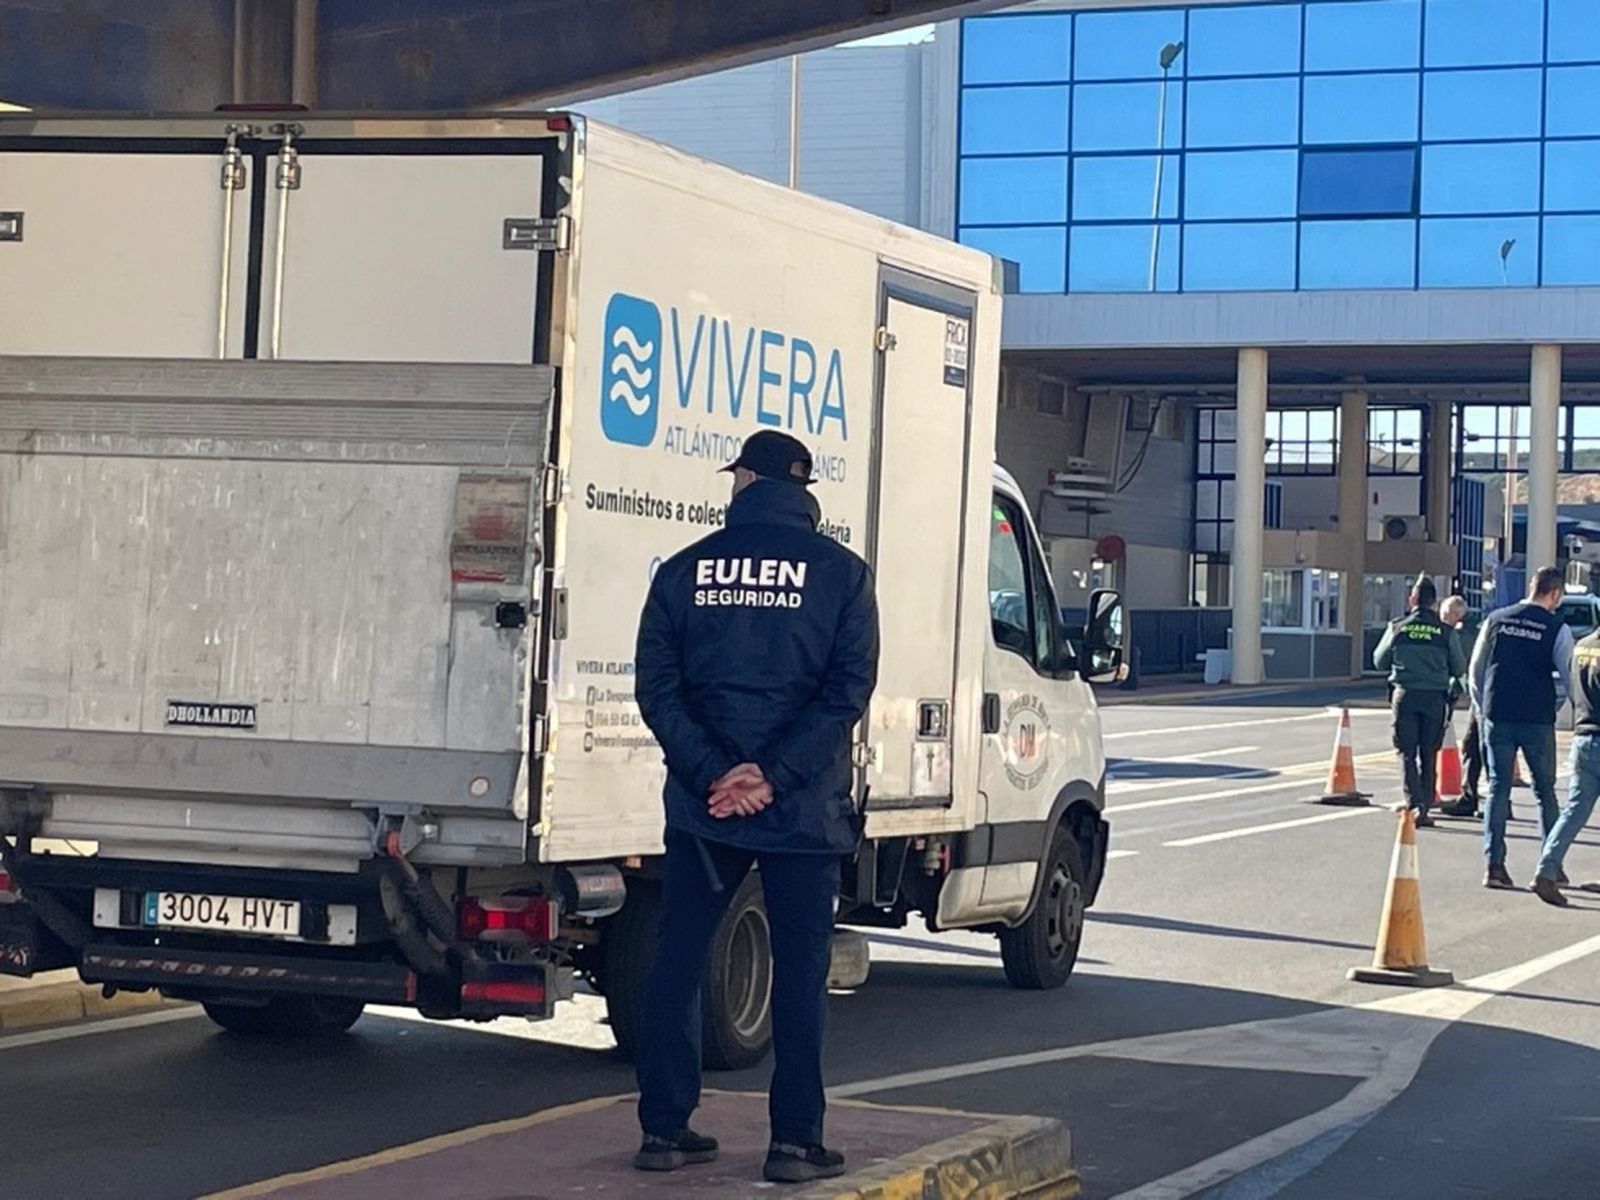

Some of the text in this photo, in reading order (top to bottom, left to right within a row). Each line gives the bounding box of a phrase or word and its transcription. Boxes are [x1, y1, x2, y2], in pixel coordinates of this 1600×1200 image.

[671, 307, 847, 441] VIVERA
[664, 423, 846, 483] ATLÁNTICO ÁNEO
[586, 483, 673, 520] Suministros
[676, 502, 685, 521] a
[817, 518, 851, 544] elería
[696, 558, 807, 588] EULEN
[694, 589, 802, 609] SEGURIDAD
[168, 705, 256, 726] DHOLLANDIA
[162, 894, 294, 931] 3004 HVT
